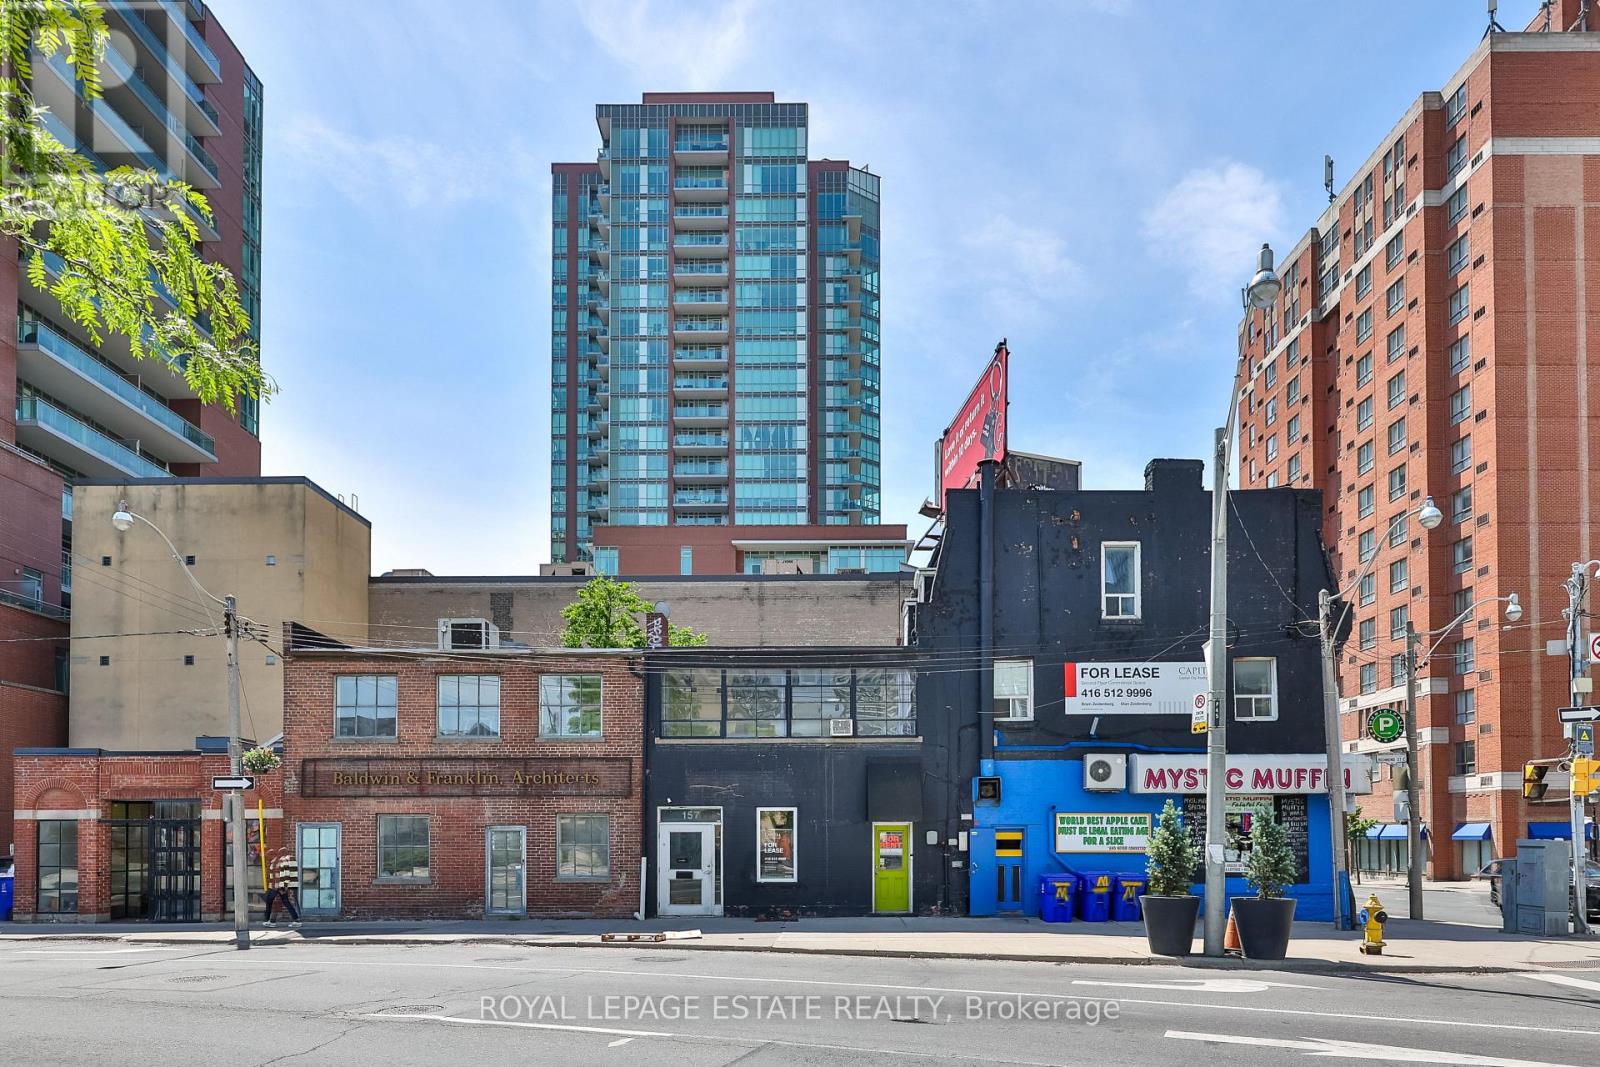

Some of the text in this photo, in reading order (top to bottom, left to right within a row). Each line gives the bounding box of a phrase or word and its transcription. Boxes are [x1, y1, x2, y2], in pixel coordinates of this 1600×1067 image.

[944, 439, 956, 460] Love
[964, 402, 981, 431] return
[1081, 667, 1160, 679] FOR LEASE
[1178, 666, 1207, 675] CAPIT
[1081, 688, 1152, 698] 416 512 9996
[1380, 718, 1393, 731] P
[333, 771, 400, 785] Baldwin
[406, 772, 420, 785] &
[1144, 768, 1244, 789] MYSTC
[682, 811, 700, 820] 157
[1059, 816, 1147, 825] WORLD BEST APPLE CAKE
[1058, 827, 1148, 835] MUST BE LEGAL EATING AGE
[1083, 837, 1124, 845] FOR A SLICE
